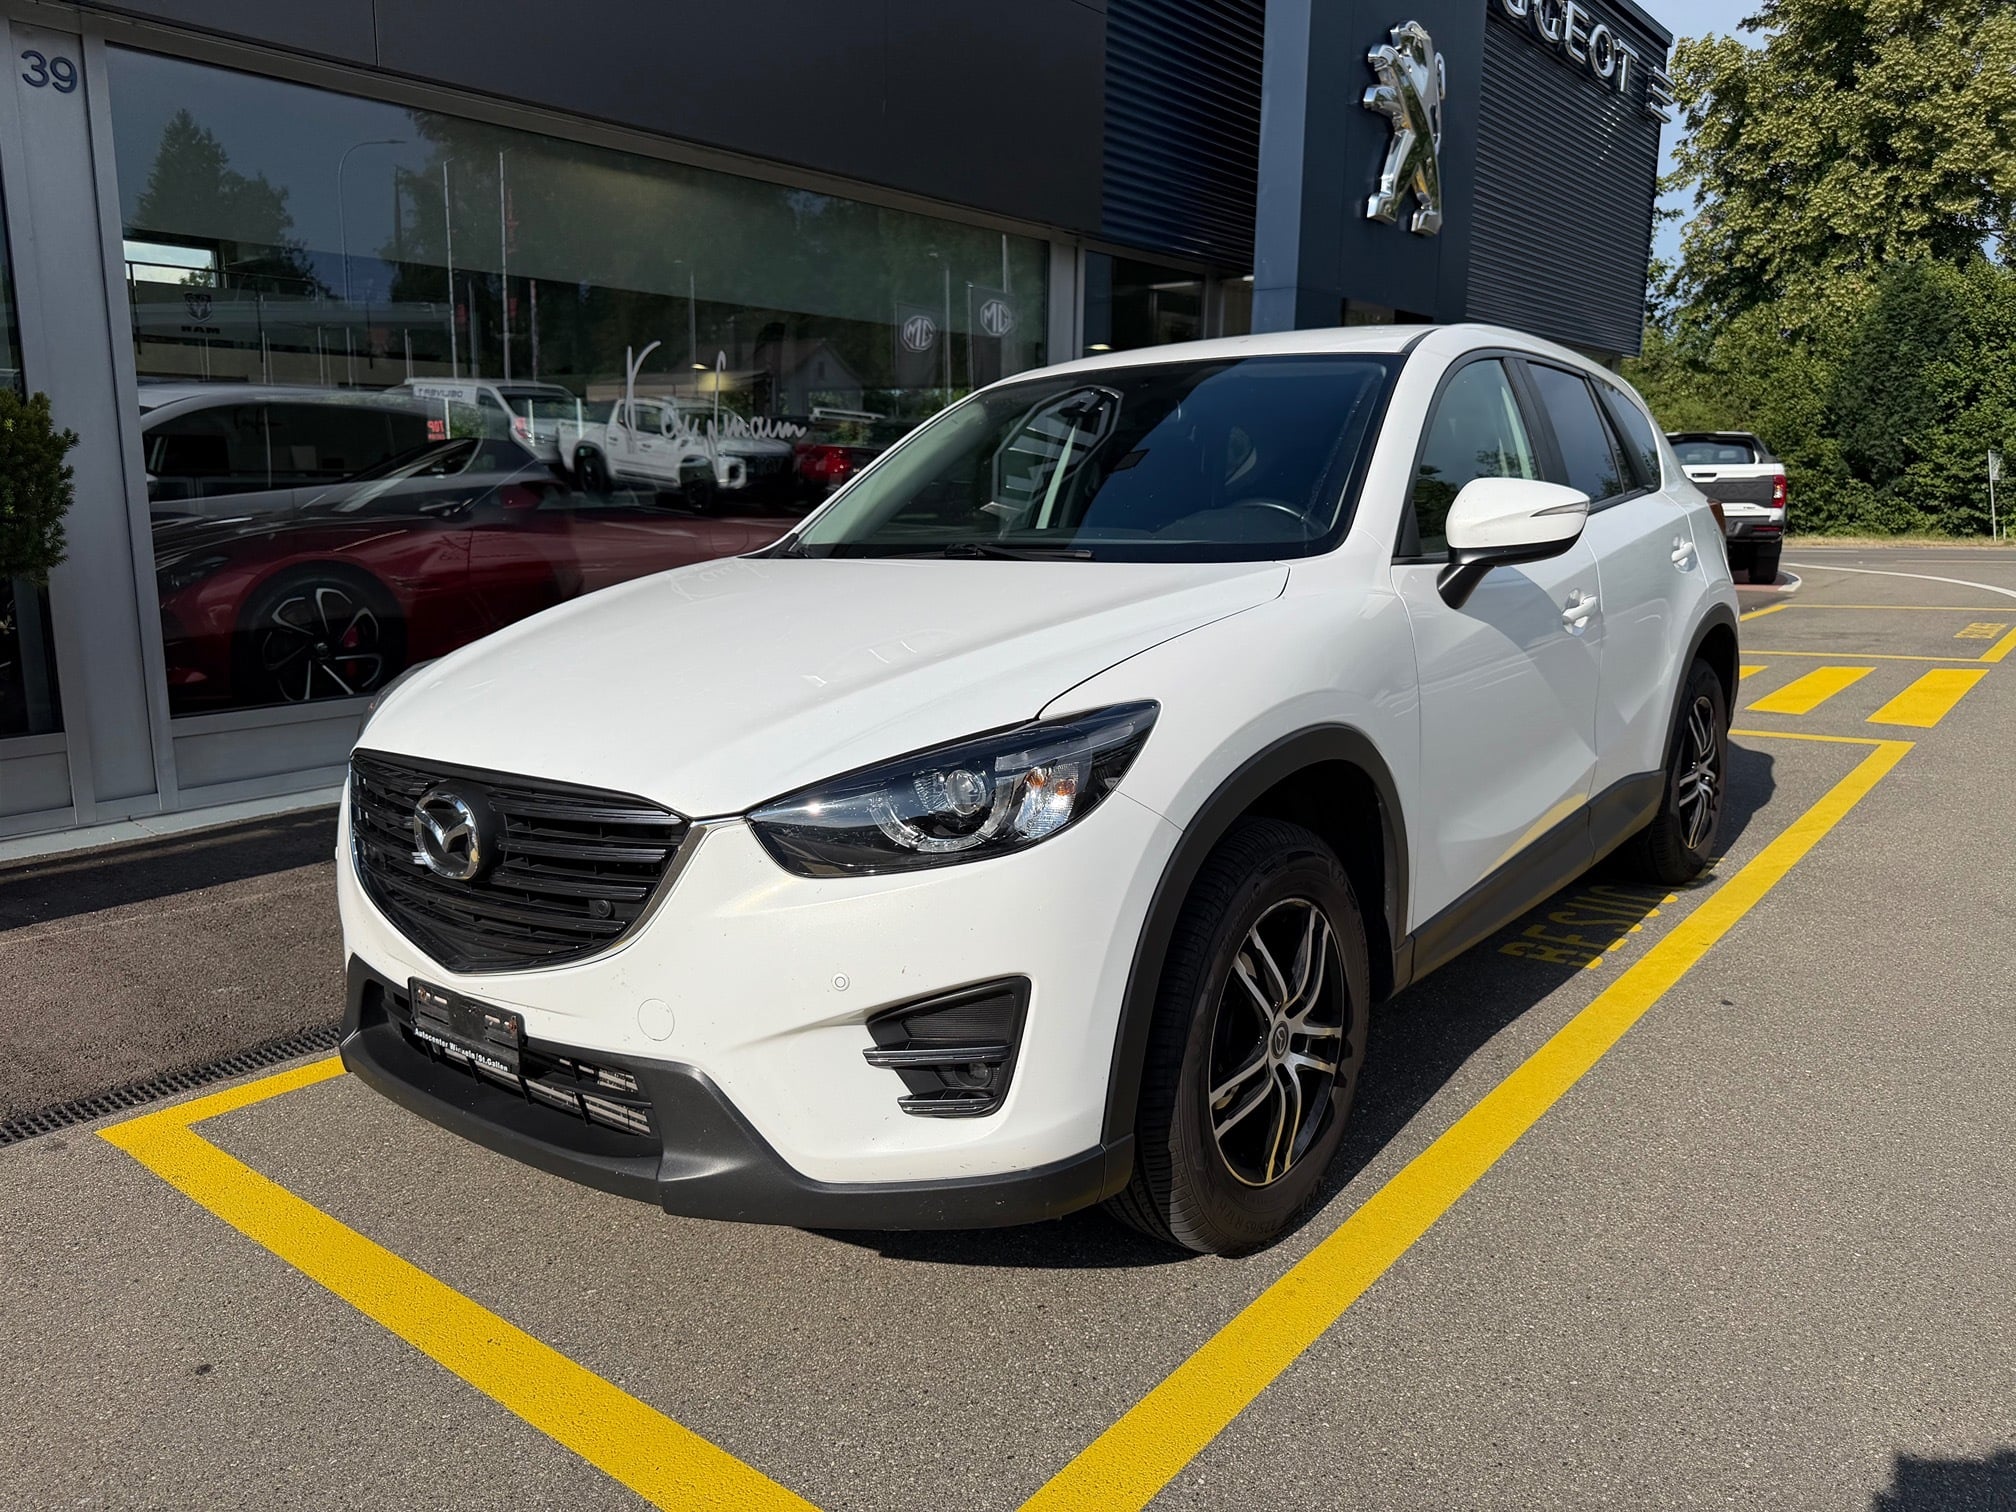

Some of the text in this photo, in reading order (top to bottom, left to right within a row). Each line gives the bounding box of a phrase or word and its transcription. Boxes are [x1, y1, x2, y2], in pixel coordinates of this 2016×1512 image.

[20, 50, 78, 94] 39
[905, 317, 934, 348] MG
[983, 301, 1010, 334] MG
[414, 1027, 448, 1048] Autocenter
